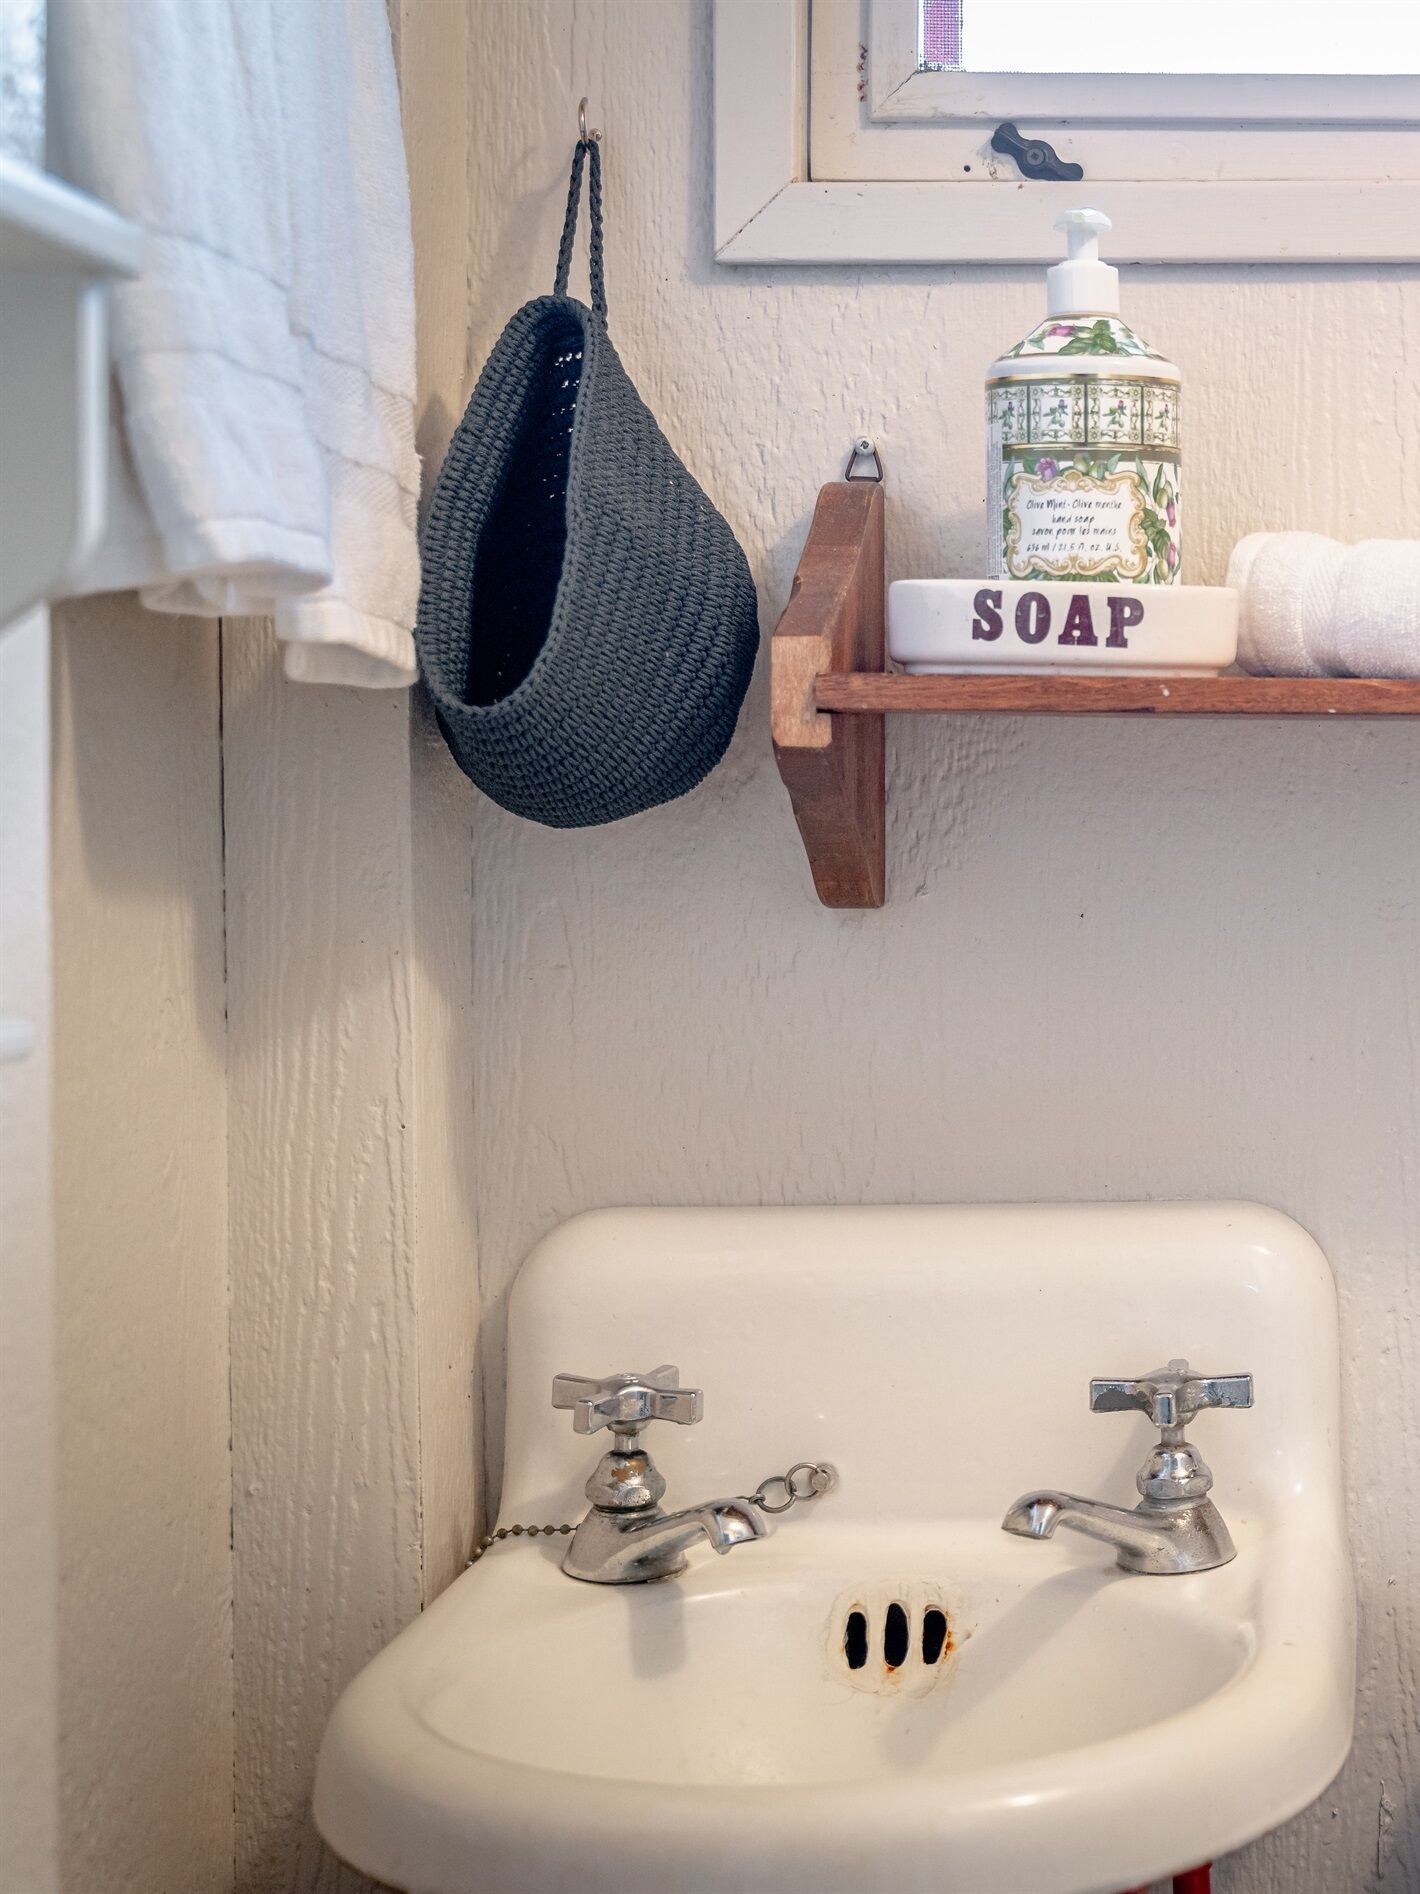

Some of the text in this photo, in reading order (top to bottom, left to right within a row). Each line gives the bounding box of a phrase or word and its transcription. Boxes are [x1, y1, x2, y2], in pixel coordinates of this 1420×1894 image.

[1026, 500, 1044, 510] Olive
[1046, 499, 1066, 510] Mint
[1072, 499, 1092, 509] Olive
[1052, 514, 1095, 527] hand soap
[1056, 528, 1076, 539] pour
[1079, 526, 1090, 535] les
[1041, 542, 1050, 551] ml
[972, 588, 1145, 648] SOAP
